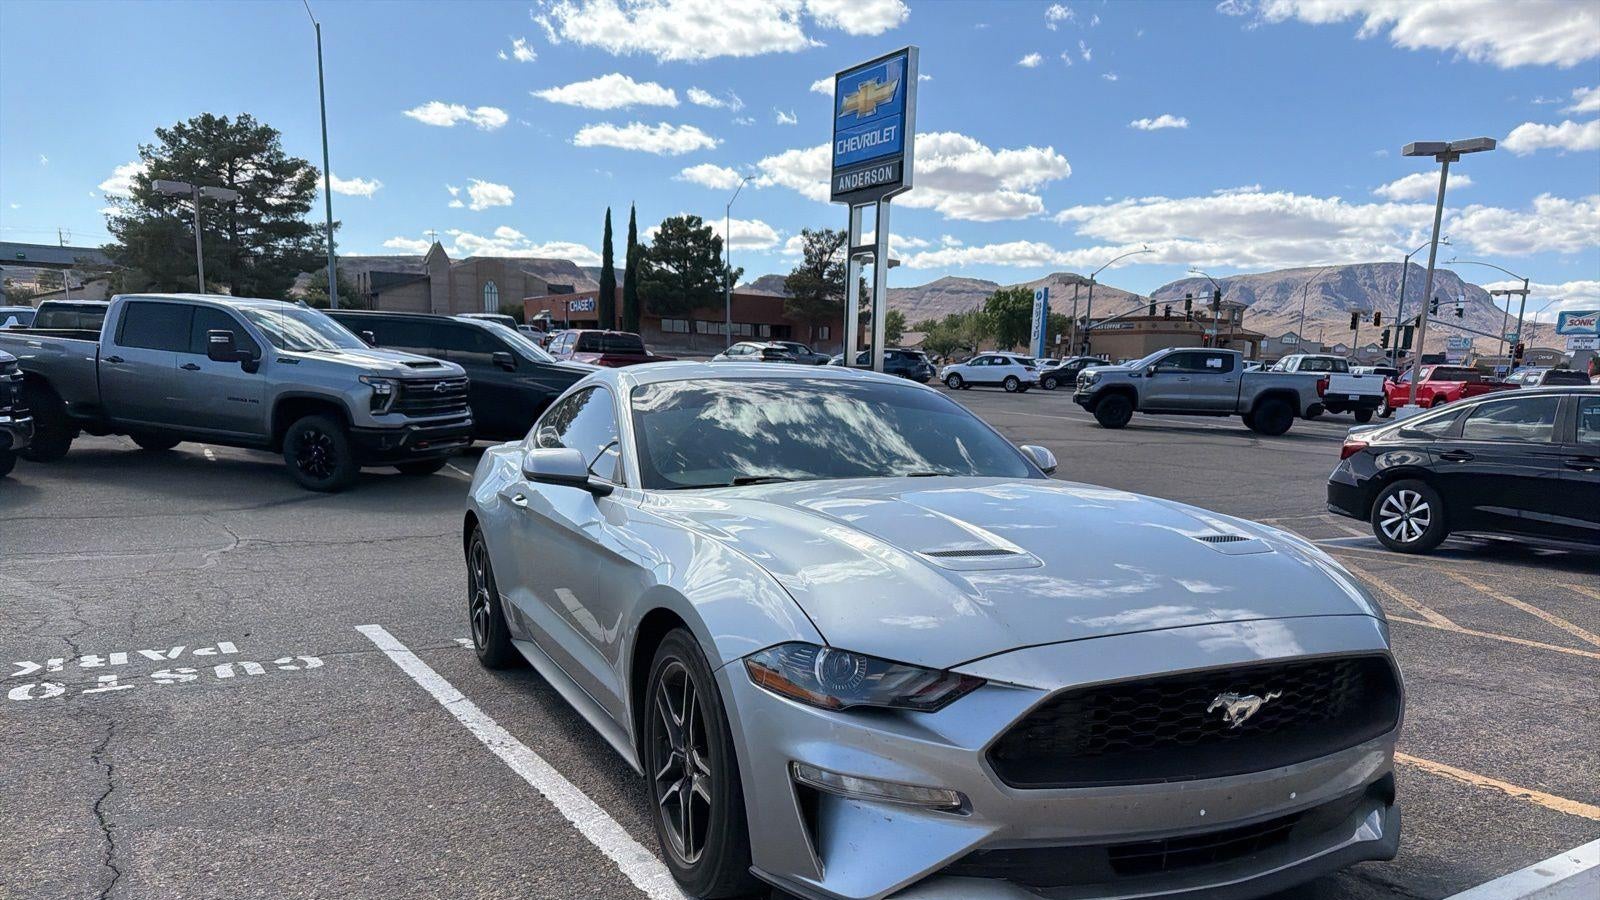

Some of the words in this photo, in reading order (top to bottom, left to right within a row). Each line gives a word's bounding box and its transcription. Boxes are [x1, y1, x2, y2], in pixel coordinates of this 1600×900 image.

[837, 126, 896, 154] CHEVROLET
[839, 165, 892, 190] ANDERSON
[570, 299, 589, 312] CHASE
[1567, 318, 1596, 327] SONIC
